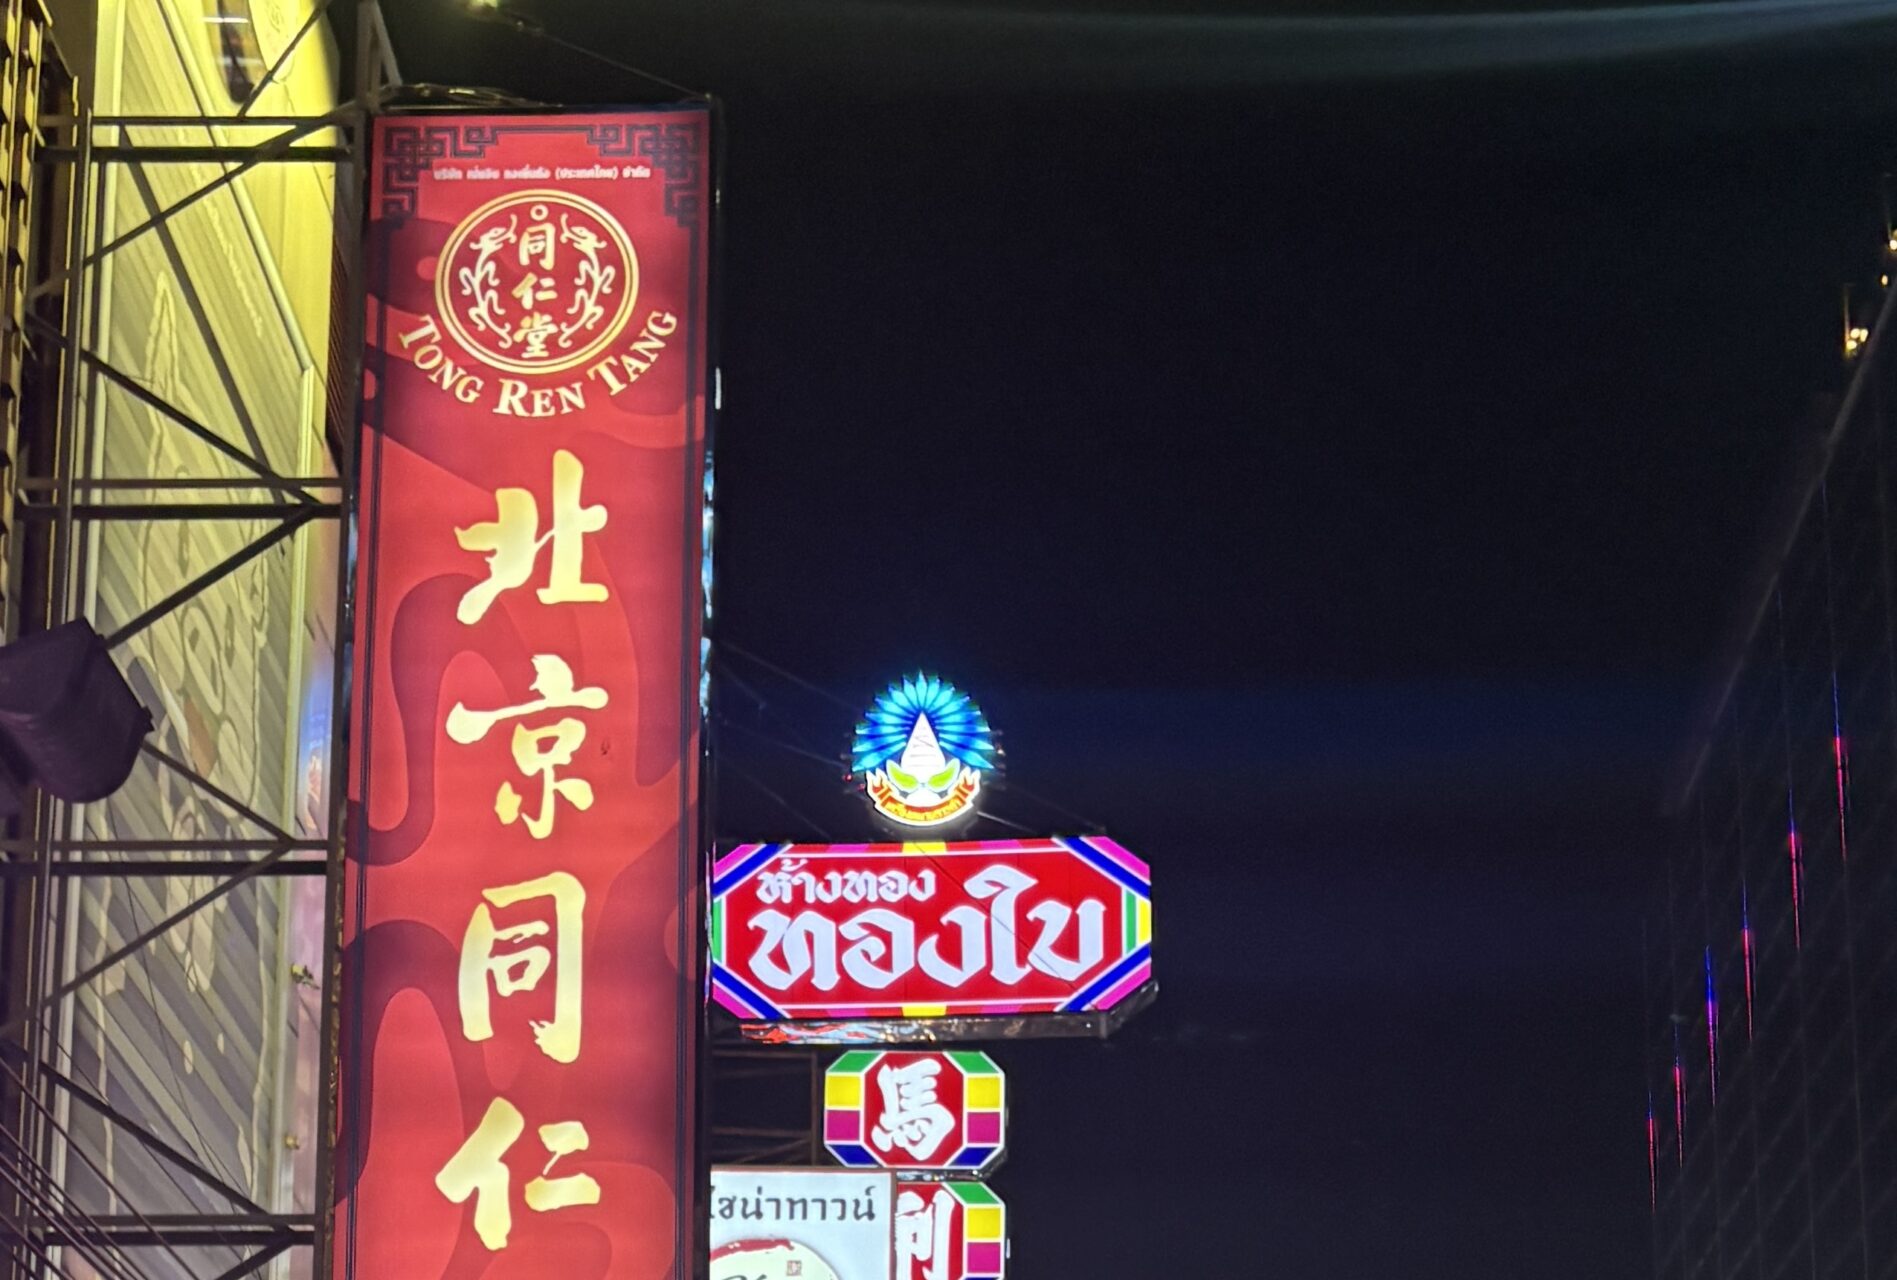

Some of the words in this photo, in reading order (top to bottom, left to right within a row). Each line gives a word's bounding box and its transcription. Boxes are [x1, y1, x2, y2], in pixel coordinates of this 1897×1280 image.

[511, 222, 560, 358] 同仁堂
[398, 313, 484, 405] TONG
[492, 377, 587, 418] REN
[586, 308, 679, 396] TANG
[747, 864, 1107, 991] ทองใบ
[756, 856, 937, 903] ห้างทอง
